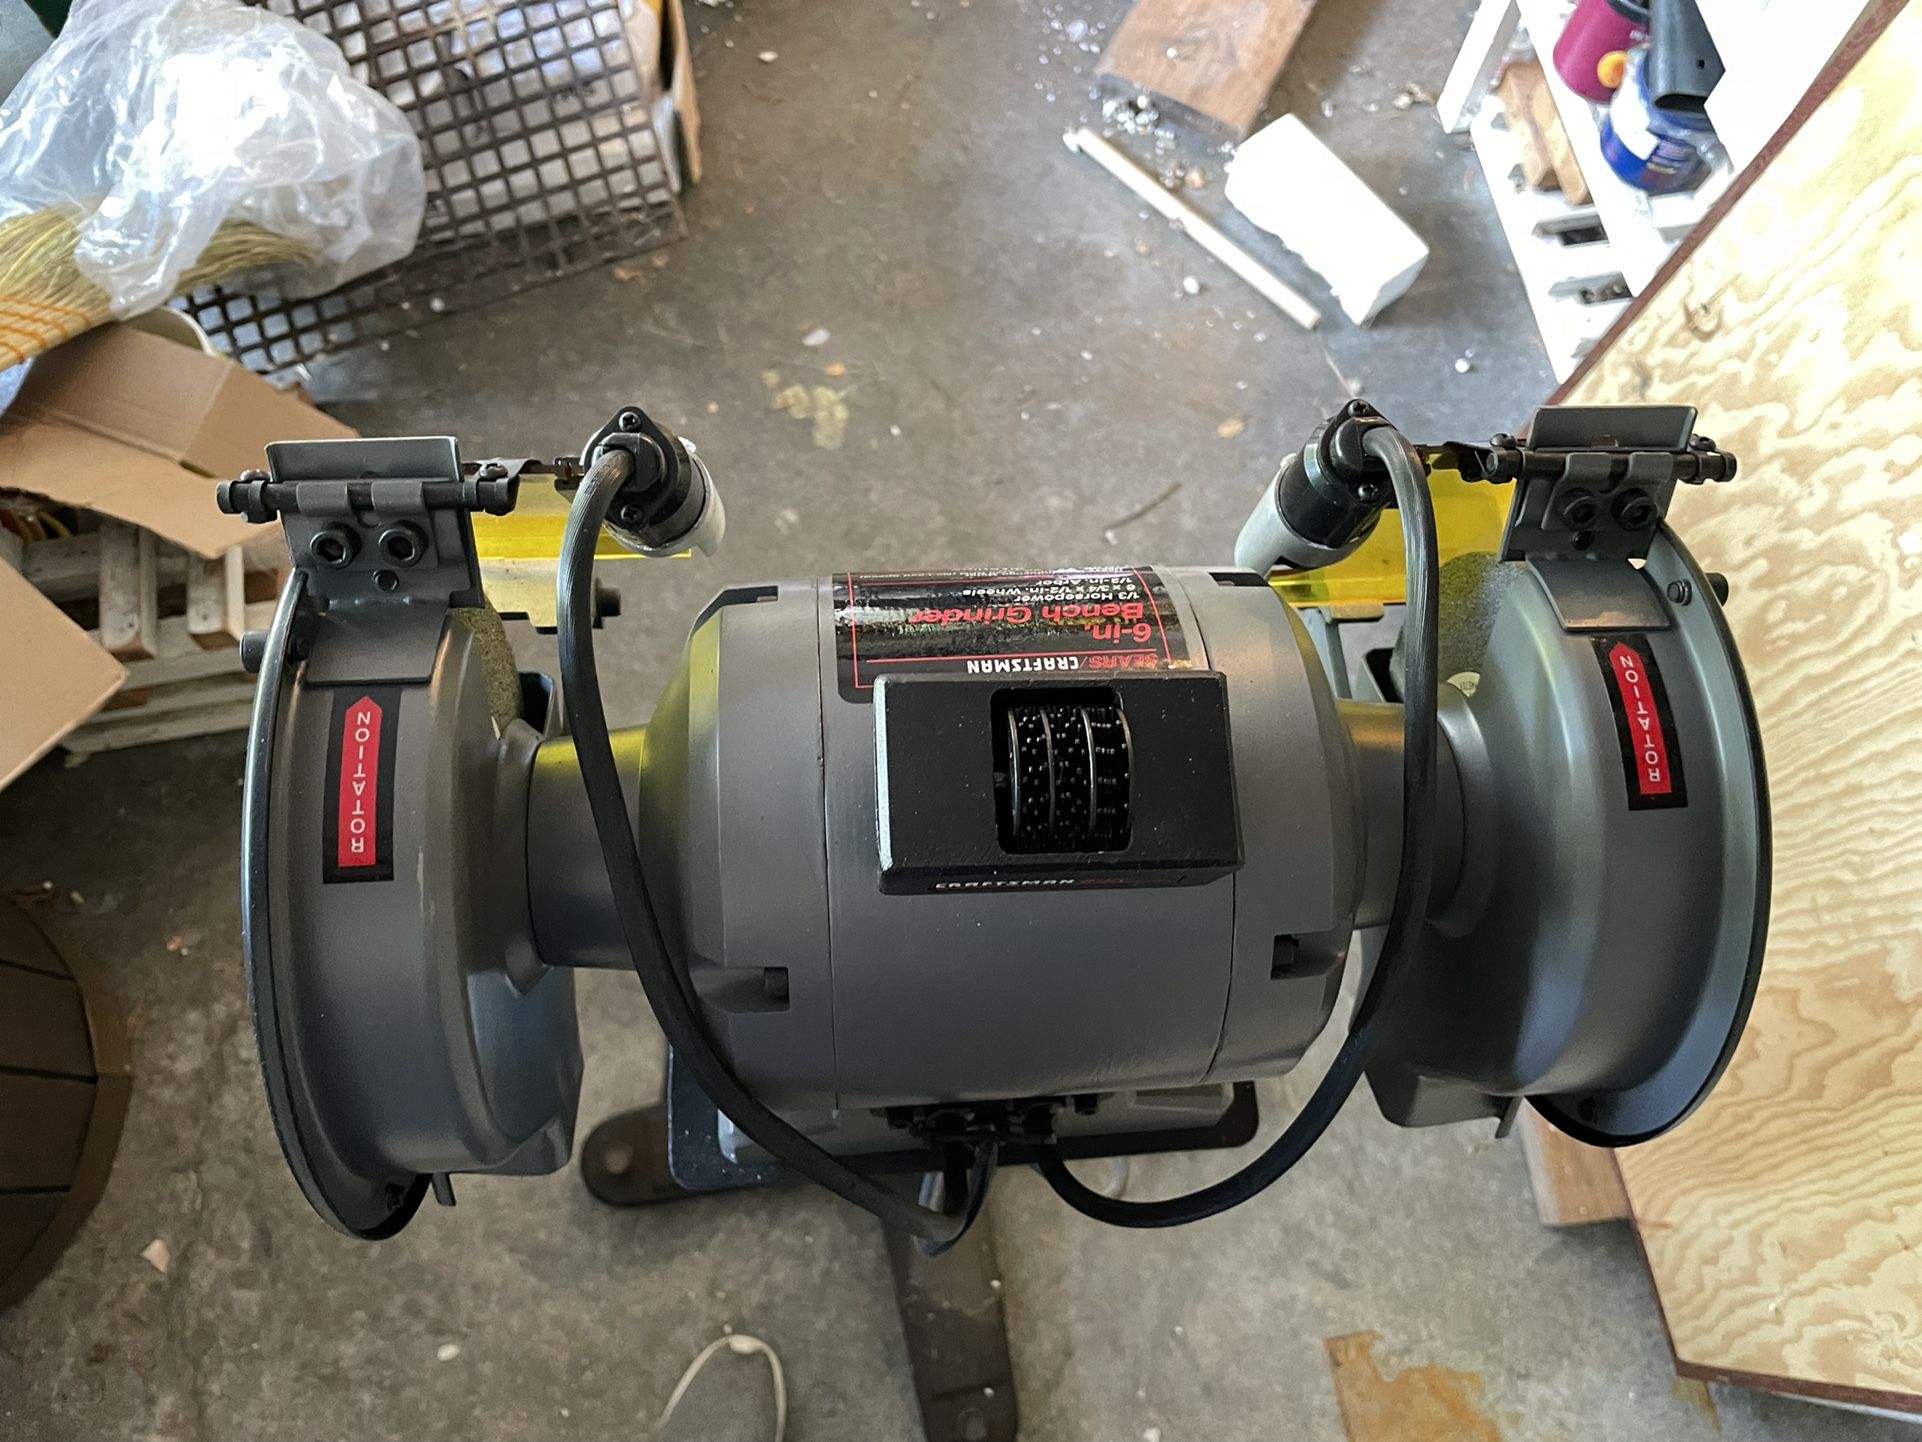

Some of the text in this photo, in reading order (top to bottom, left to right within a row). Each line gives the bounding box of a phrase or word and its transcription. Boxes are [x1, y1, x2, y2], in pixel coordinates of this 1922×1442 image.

[962, 587, 1021, 596] Wheels
[1013, 591, 1140, 602] 1/3 Horsepower
[1088, 584, 1110, 592] 3/4
[907, 602, 1144, 625] Bench Grinder
[1619, 655, 1662, 782] ROTATION
[349, 711, 372, 853] ROTATION
